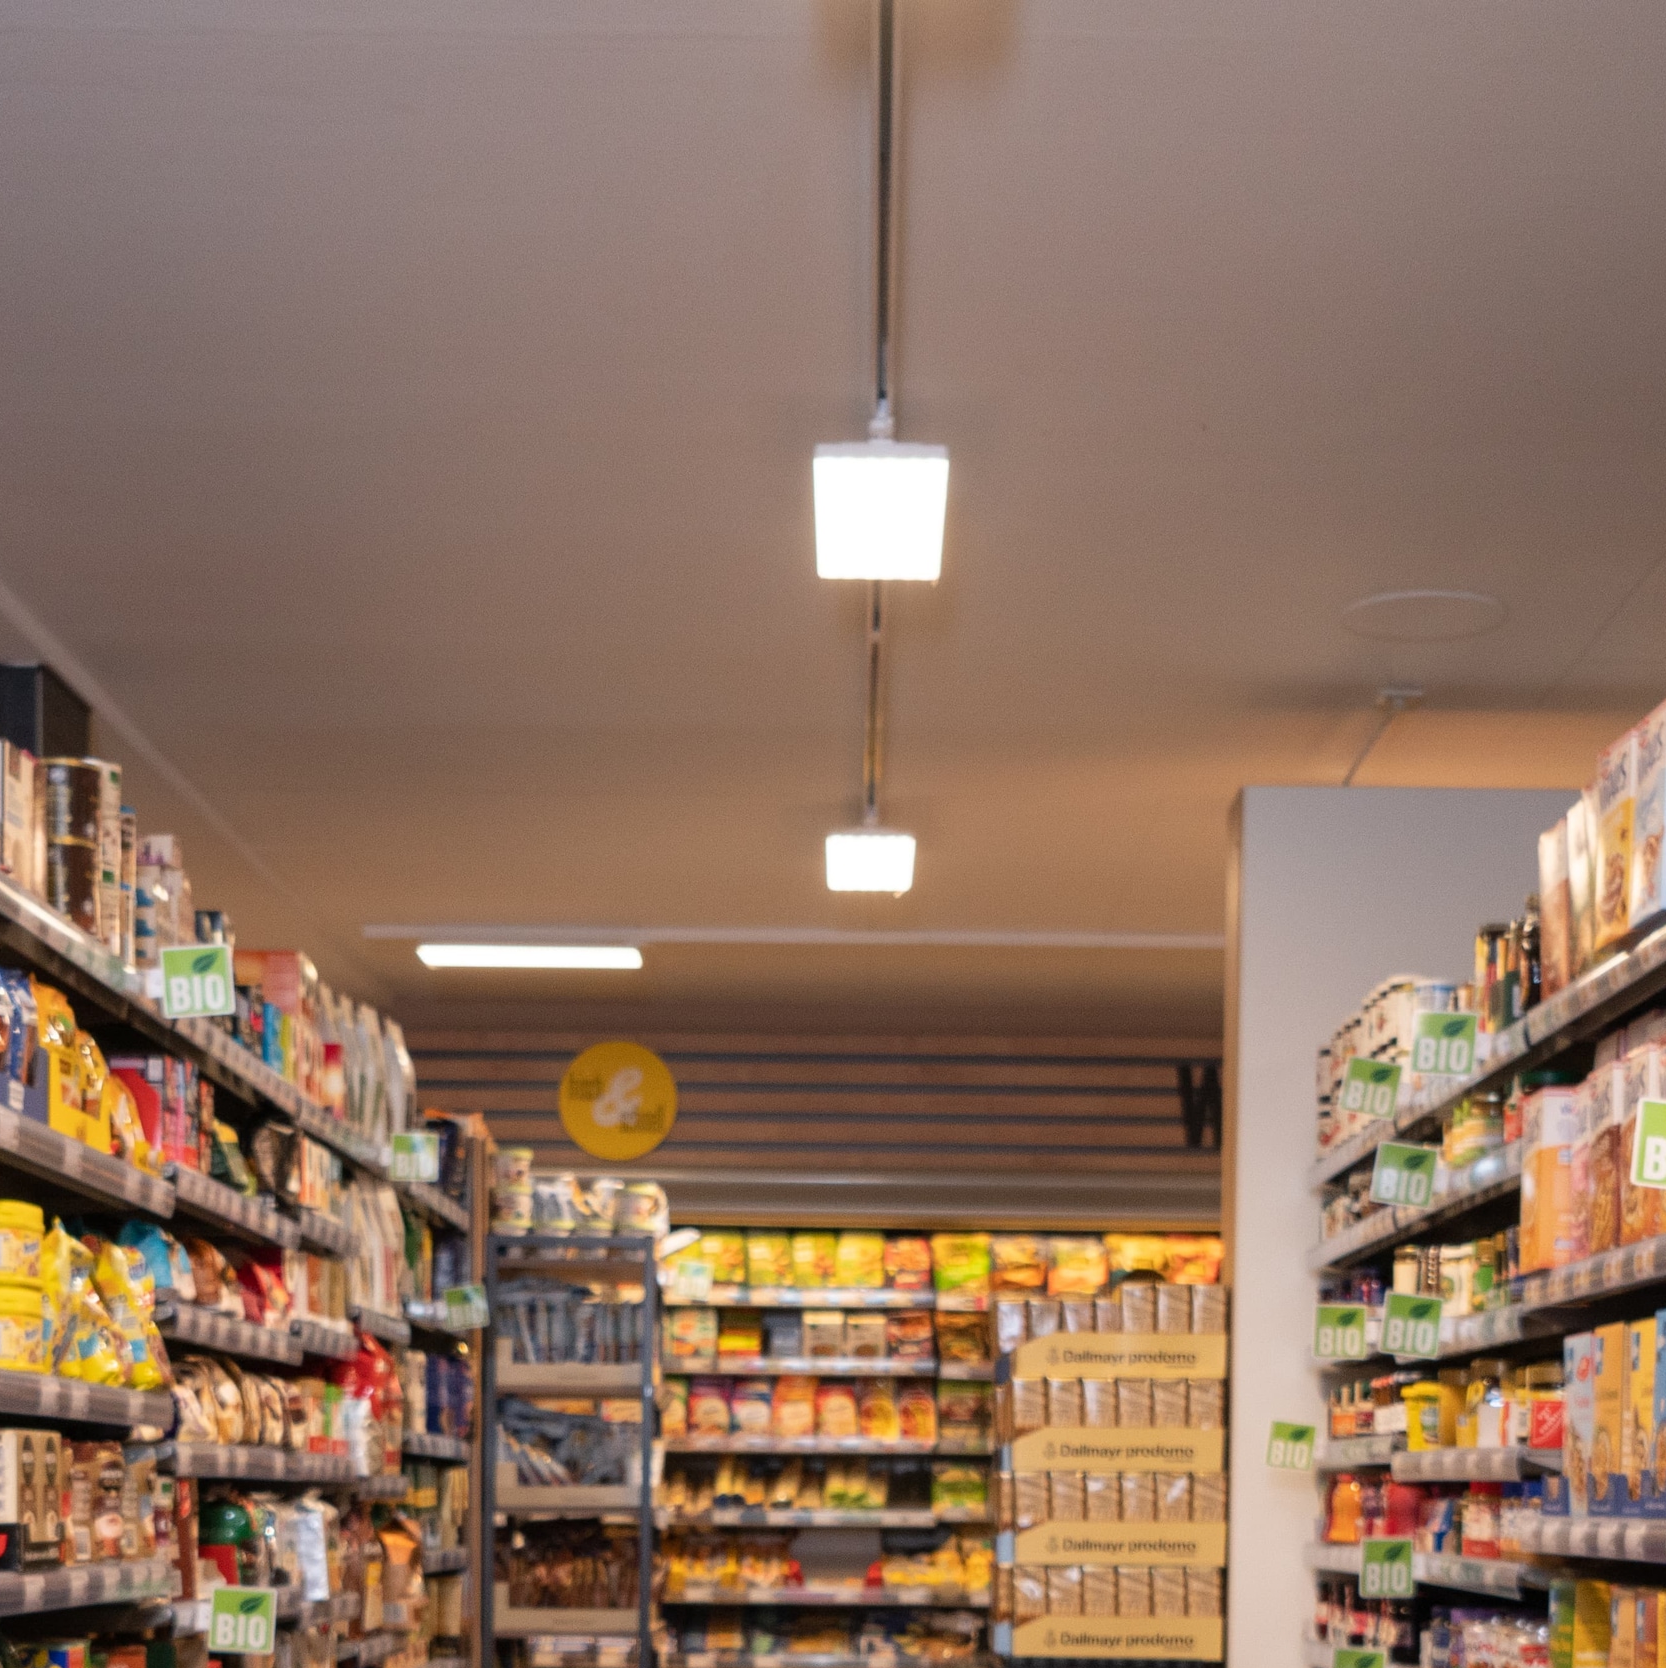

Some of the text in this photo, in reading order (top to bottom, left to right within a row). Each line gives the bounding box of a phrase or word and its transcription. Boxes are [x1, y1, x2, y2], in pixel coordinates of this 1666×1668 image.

[171, 974, 227, 1012] BIO
[1413, 1038, 1467, 1073] BIO
[1345, 1080, 1393, 1116] BIO
[1377, 1168, 1430, 1204] BIO
[1317, 1328, 1361, 1357] BIO
[1385, 1316, 1435, 1355] BIO
[1271, 1440, 1309, 1467] BIO
[1365, 1562, 1407, 1594] BIO
[215, 1612, 267, 1649] BIO
